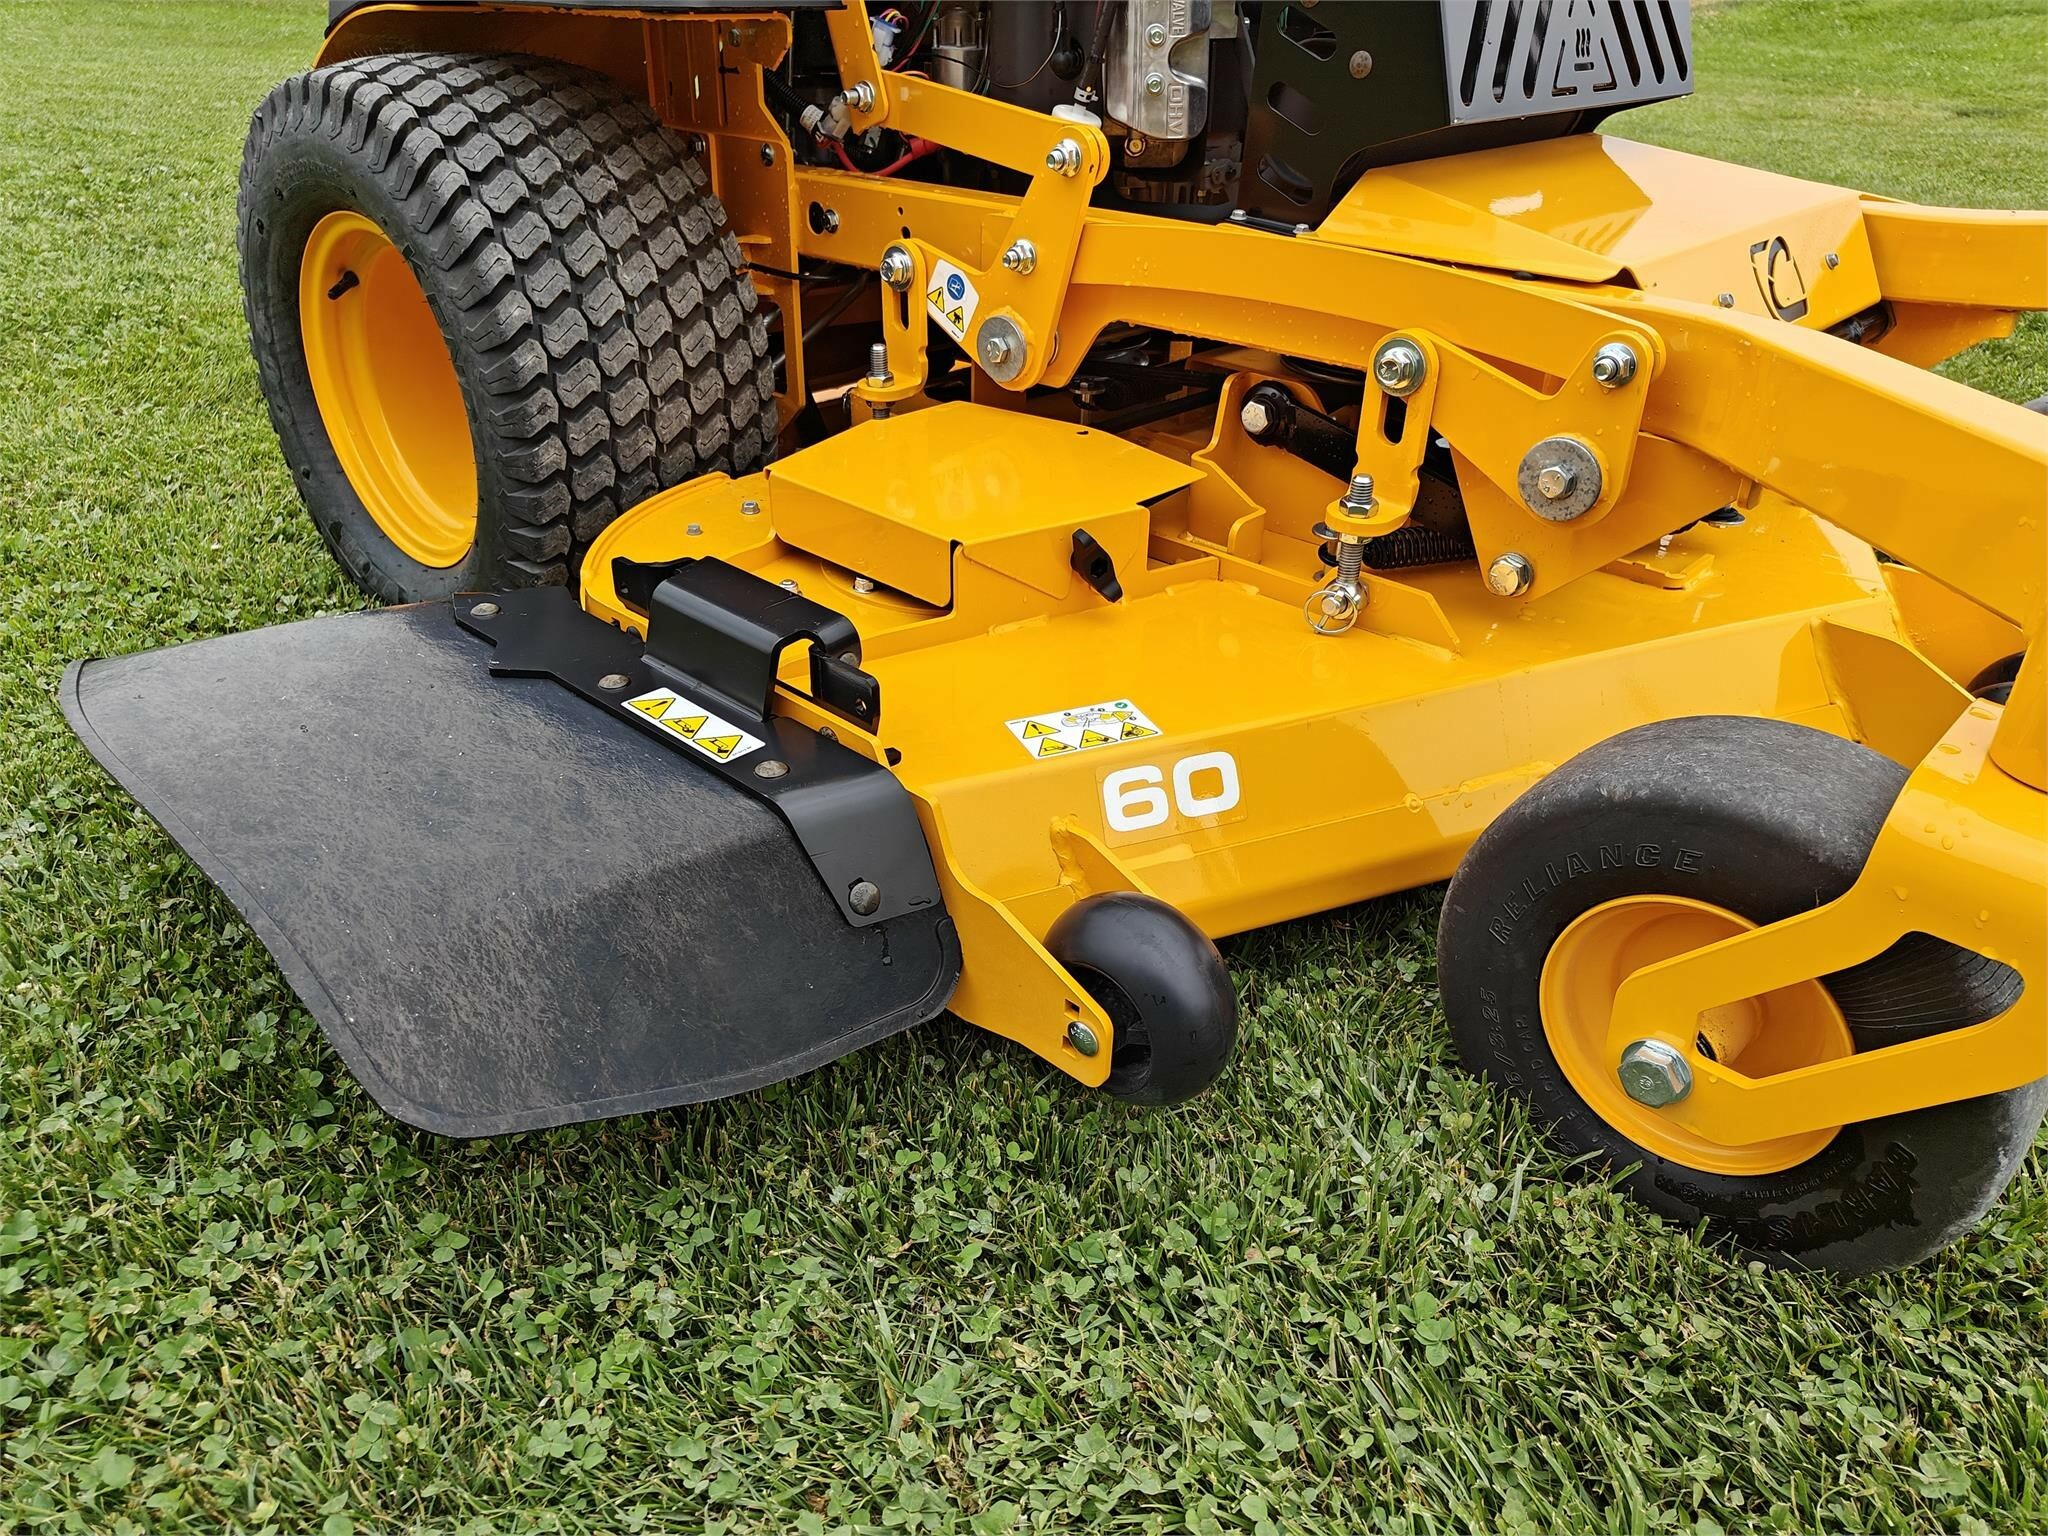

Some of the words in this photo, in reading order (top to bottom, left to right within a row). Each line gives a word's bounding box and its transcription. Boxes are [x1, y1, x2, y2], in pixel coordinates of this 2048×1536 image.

[1168, 85, 1183, 136] OHV
[1103, 751, 1240, 832] 60
[1488, 843, 1704, 945] RELIANCE
[1531, 1057, 1565, 1103] LOAD
